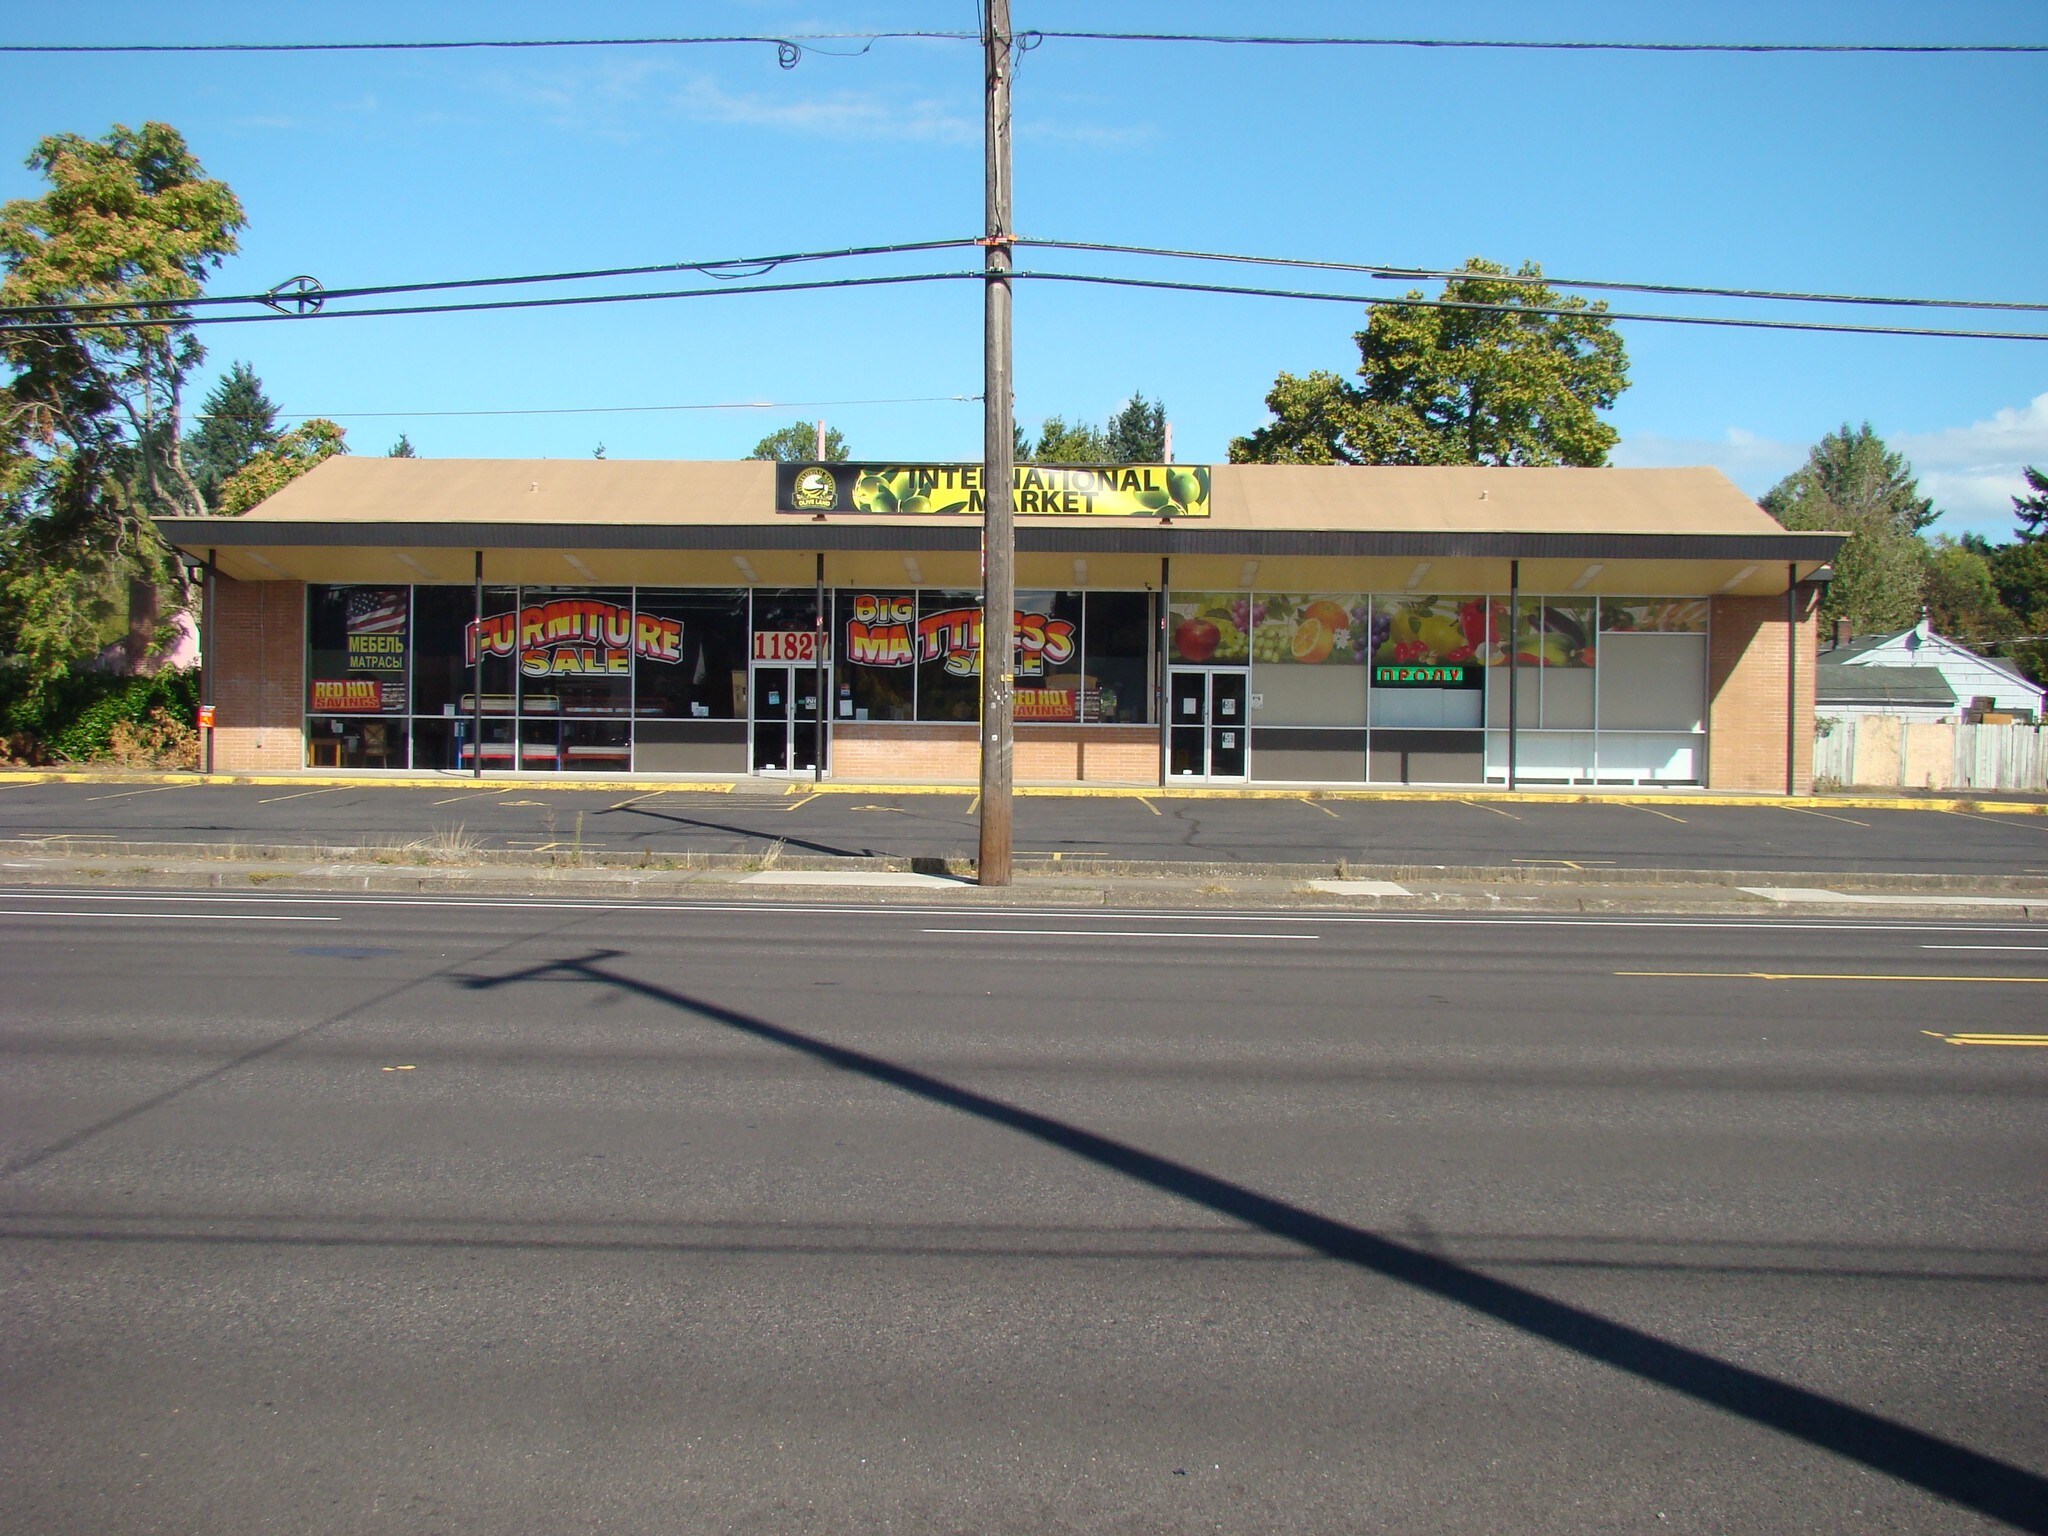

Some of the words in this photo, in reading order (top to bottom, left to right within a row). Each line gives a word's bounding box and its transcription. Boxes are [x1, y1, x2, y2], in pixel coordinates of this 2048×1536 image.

[908, 468, 1160, 492] INTEATIONAL
[968, 490, 1100, 513] MRKET
[856, 594, 914, 623] BIG
[467, 600, 682, 664] FURNITURE
[349, 636, 404, 653] МЕБЕЛЬ
[350, 656, 403, 668] МАТРАСЫ
[521, 648, 630, 677] SALE
[315, 682, 343, 697] RED
[346, 682, 375, 697] HOT
[1038, 690, 1068, 705] HOT
[316, 697, 378, 708] SAVINGS
